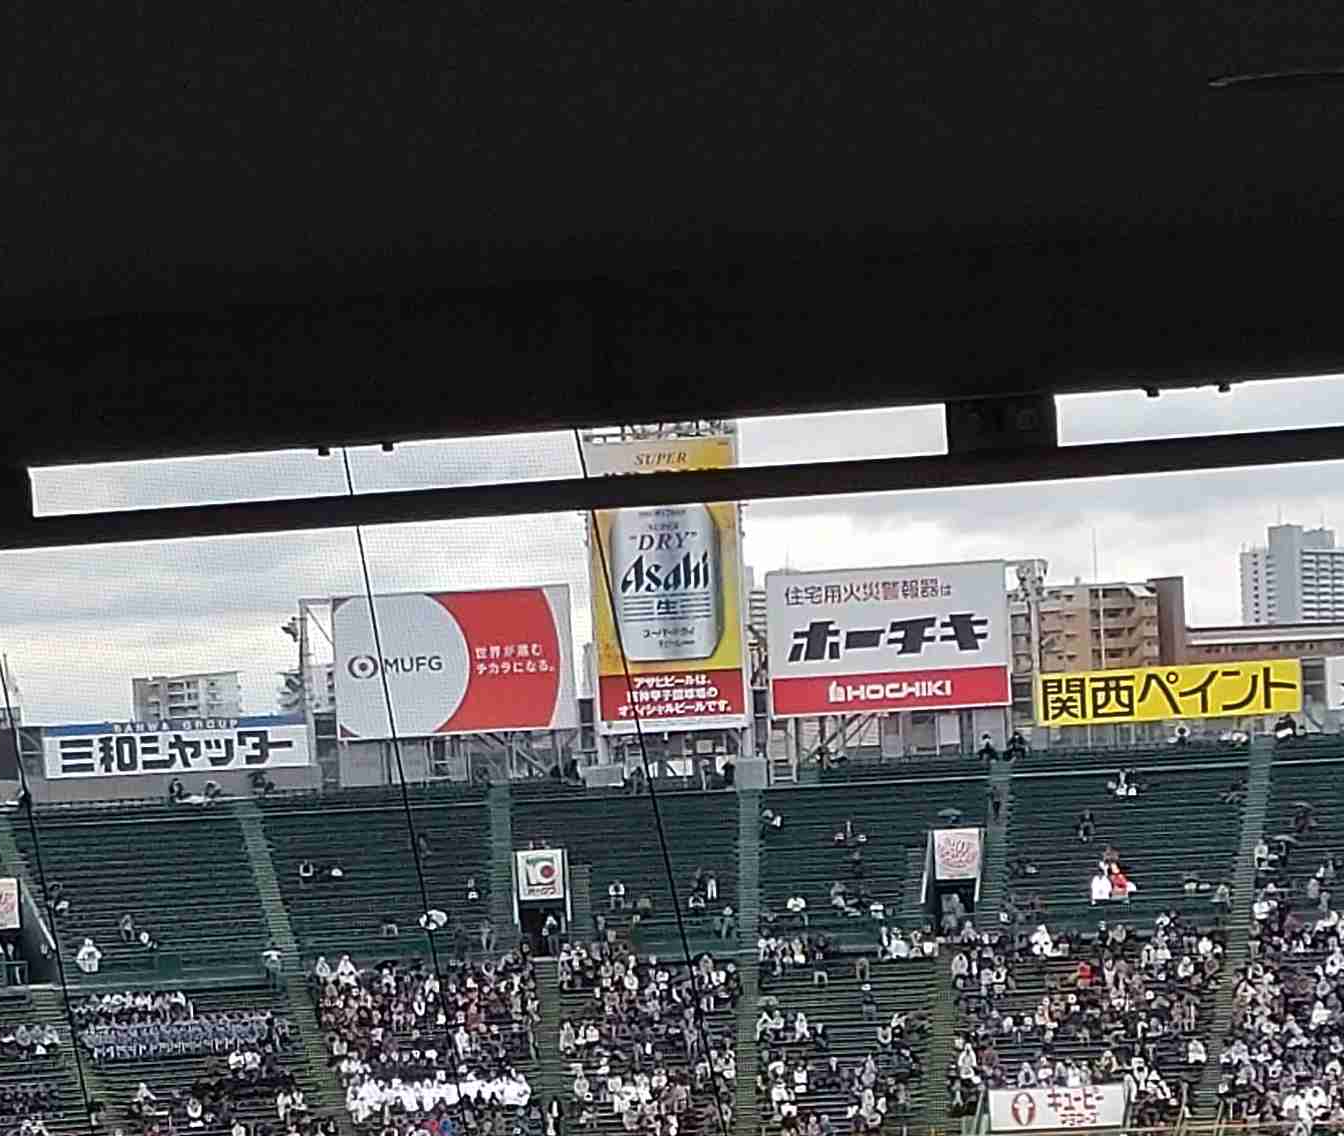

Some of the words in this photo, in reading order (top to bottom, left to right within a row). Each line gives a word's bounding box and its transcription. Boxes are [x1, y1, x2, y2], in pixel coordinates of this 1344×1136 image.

[634, 451, 688, 467] SUPER
[621, 549, 710, 593] Asahi
[787, 612, 989, 663] ホーチキ
[383, 655, 444, 674] MUFG
[847, 679, 952, 701] HOCHIKI
[1040, 667, 1299, 723] 関西ペイント
[182, 719, 240, 731] GROUP
[59, 729, 294, 773] 三和シャッター
